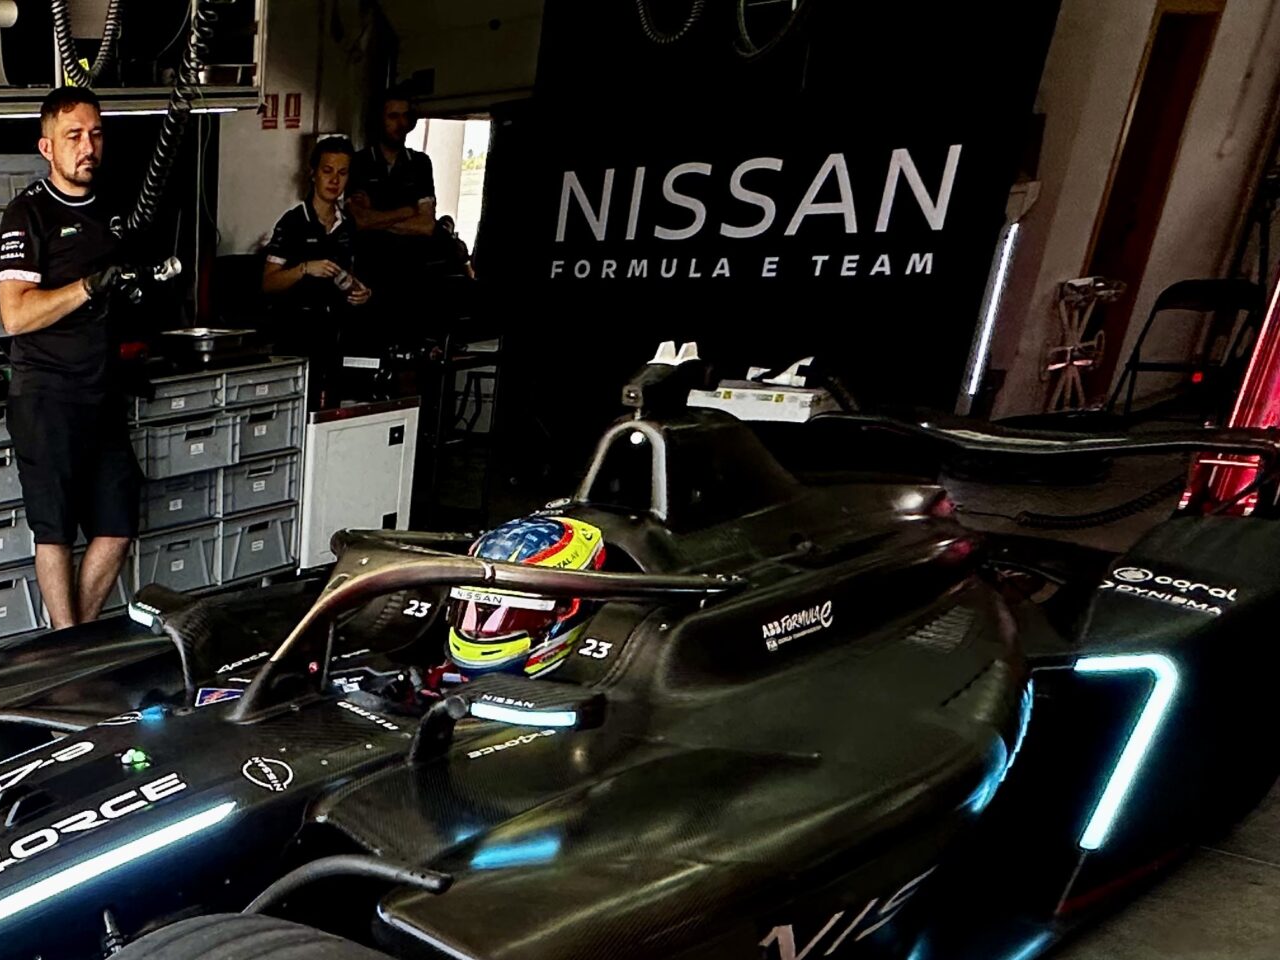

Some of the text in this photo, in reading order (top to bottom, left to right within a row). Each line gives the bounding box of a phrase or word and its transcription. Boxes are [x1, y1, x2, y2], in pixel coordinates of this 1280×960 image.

[555, 144, 962, 242] NISSAN
[550, 252, 933, 279] FORMULA E TEAM
[403, 600, 431, 618] 23
[578, 639, 613, 659] 23
[481, 694, 536, 709] NISSAN
[251, 757, 283, 791] NISSAN
